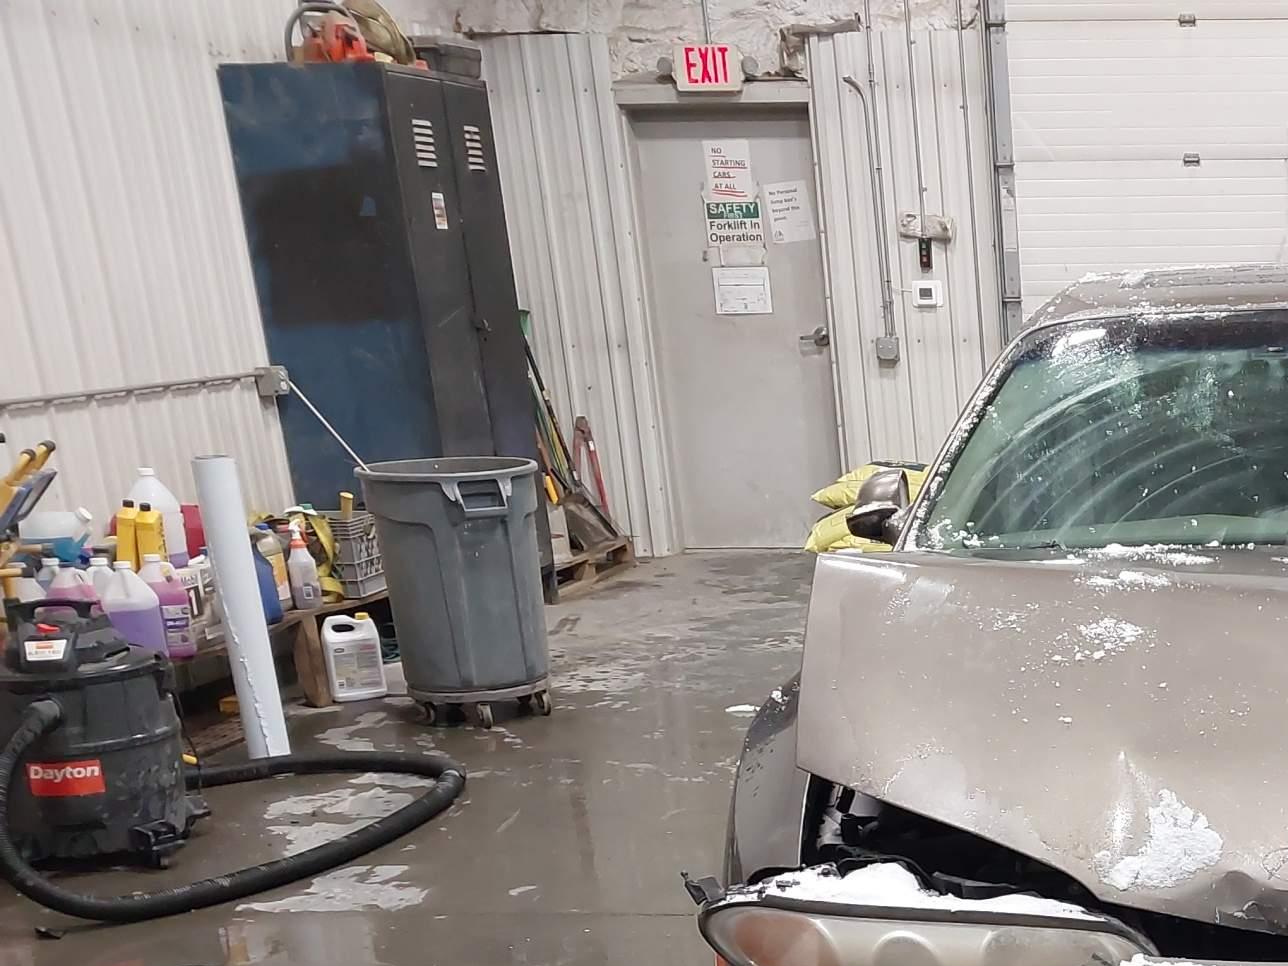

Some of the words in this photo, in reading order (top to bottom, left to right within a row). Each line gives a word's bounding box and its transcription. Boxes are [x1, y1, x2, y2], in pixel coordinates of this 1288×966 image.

[684, 47, 728, 83] EXIT
[712, 159, 746, 167] STARTING
[709, 203, 755, 214] SAFETY
[709, 220, 748, 231] Forklift
[750, 220, 761, 230] In
[709, 232, 763, 244] Operation
[29, 765, 100, 784] Dayton
